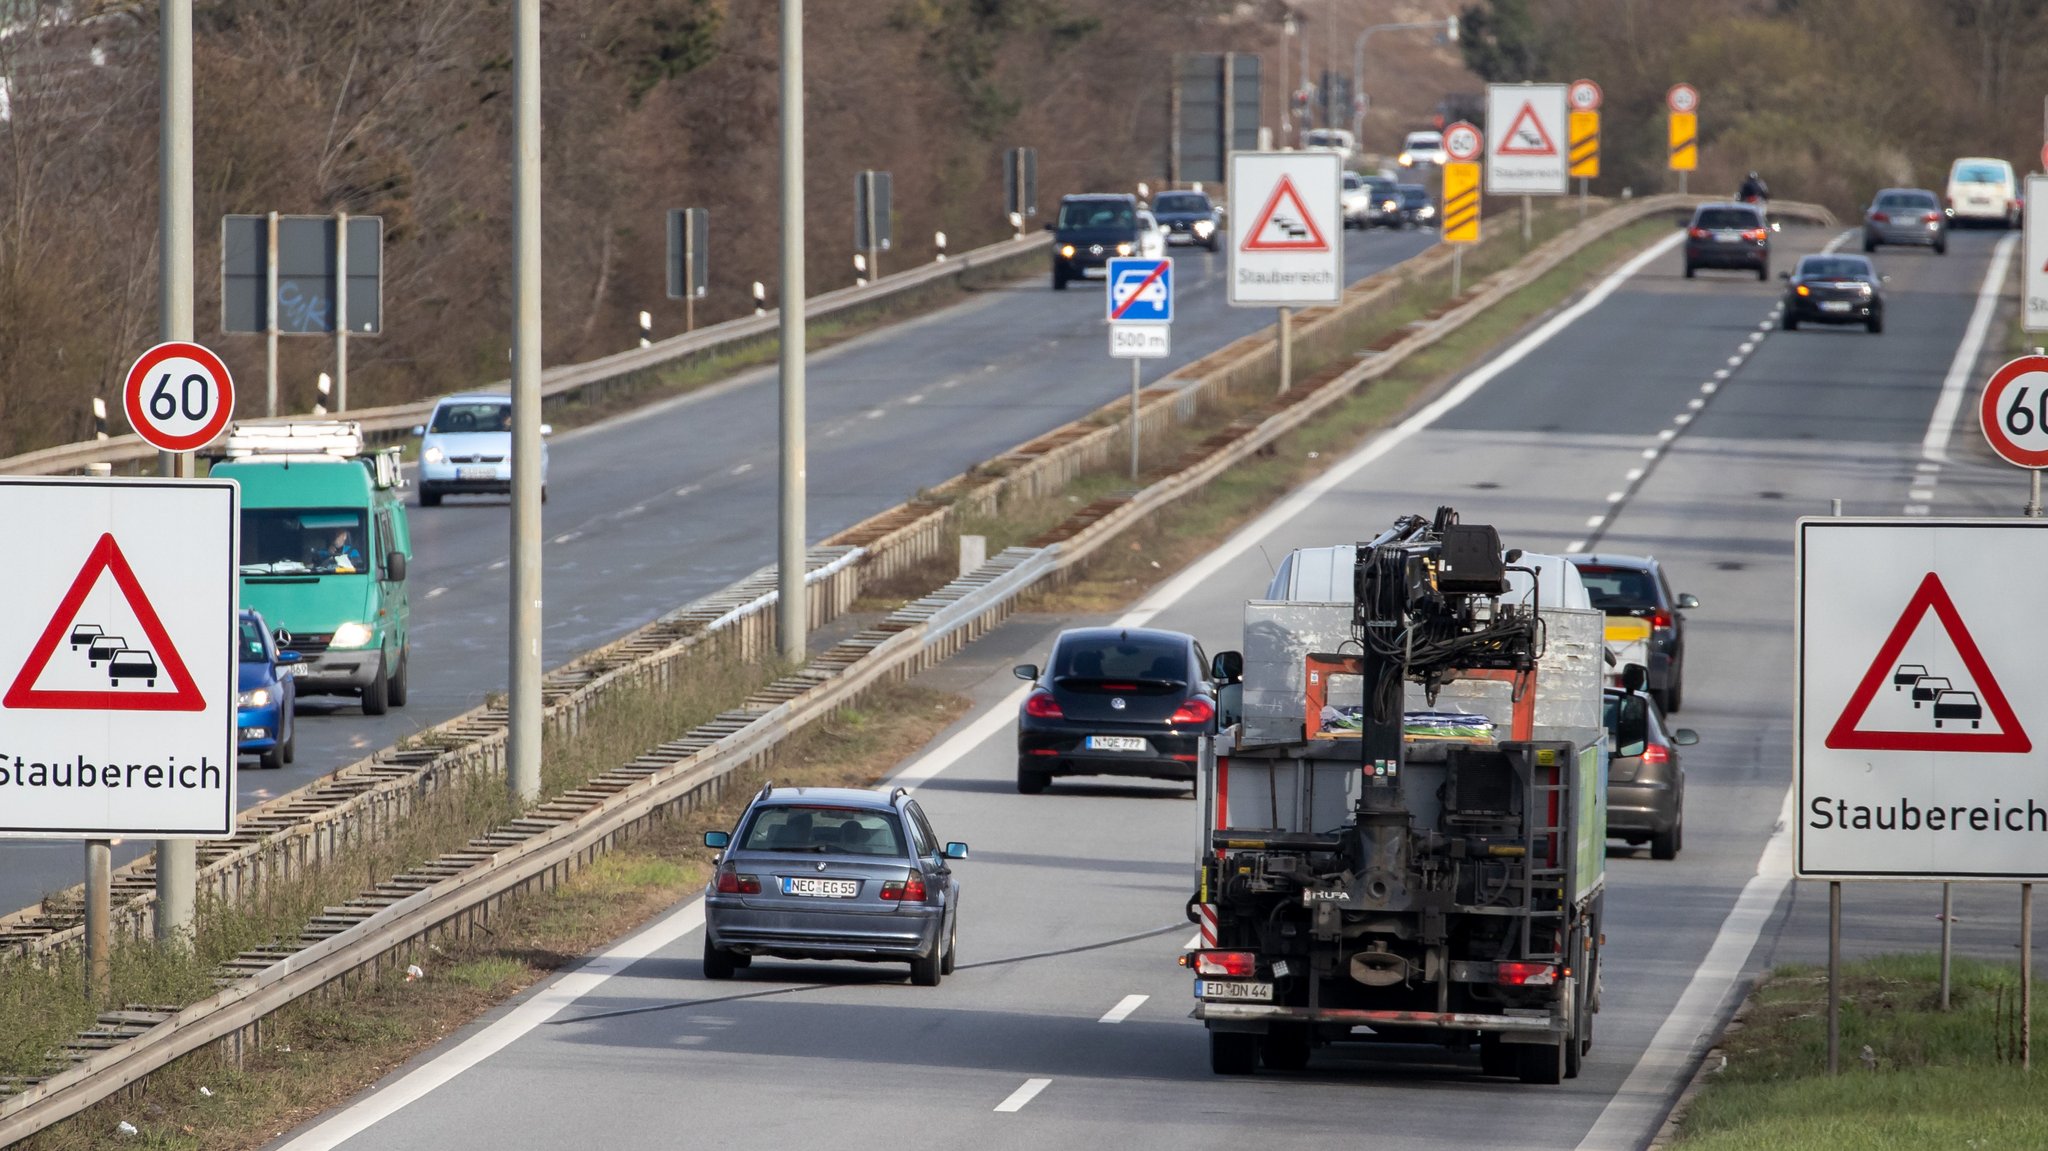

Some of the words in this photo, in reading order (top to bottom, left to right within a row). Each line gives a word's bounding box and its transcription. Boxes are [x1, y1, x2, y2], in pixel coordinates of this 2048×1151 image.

[1118, 332, 1146, 347] 500
[1150, 336, 1165, 346] m
[149, 373, 209, 421] 60
[1123, 739, 1142, 748] 777
[1810, 796, 2047, 831] Staubereich
[791, 879, 815, 892] NEC
[823, 881, 838, 894] EG
[840, 882, 856, 894] 55
[1207, 983, 1223, 996] ED
[1232, 984, 1249, 997] DN
[1251, 985, 1267, 998] 44
